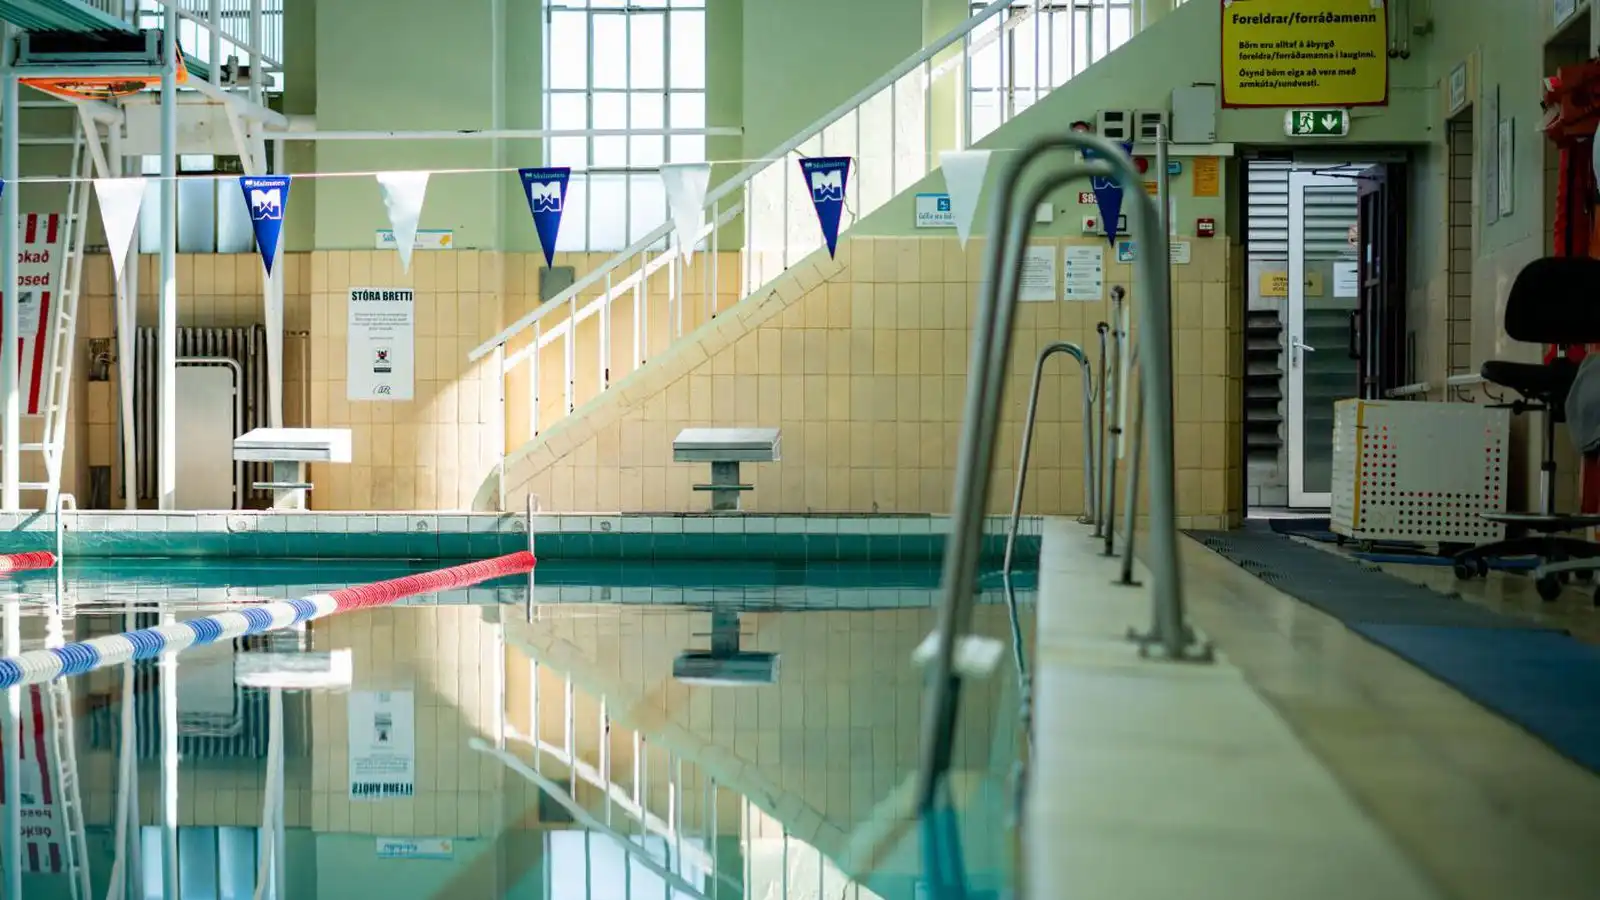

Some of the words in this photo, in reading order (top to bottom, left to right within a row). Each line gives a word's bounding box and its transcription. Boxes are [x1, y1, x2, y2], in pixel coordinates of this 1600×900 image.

[1232, 12, 1376, 25] Foreldrar/forráðamenn
[1239, 41, 1258, 49] Börn
[1276, 40, 1297, 49] alltaf
[1306, 40, 1335, 50] ábyrgð
[1239, 51, 1334, 60] foreldra/forráðamanna
[1340, 50, 1376, 60] lauginni.
[1239, 68, 1265, 78] Ósynd
[1266, 68, 1285, 76] börn
[1287, 68, 1305, 78] eiga
[1306, 68, 1317, 76] að
[1338, 67, 1357, 76] með
[1239, 80, 1320, 89] armkúta/sundvesti.
[18, 249, 49, 263] okað
[18, 272, 50, 285] osed
[351, 289, 381, 301] STÓRA
[382, 291, 413, 301] BRETTI
